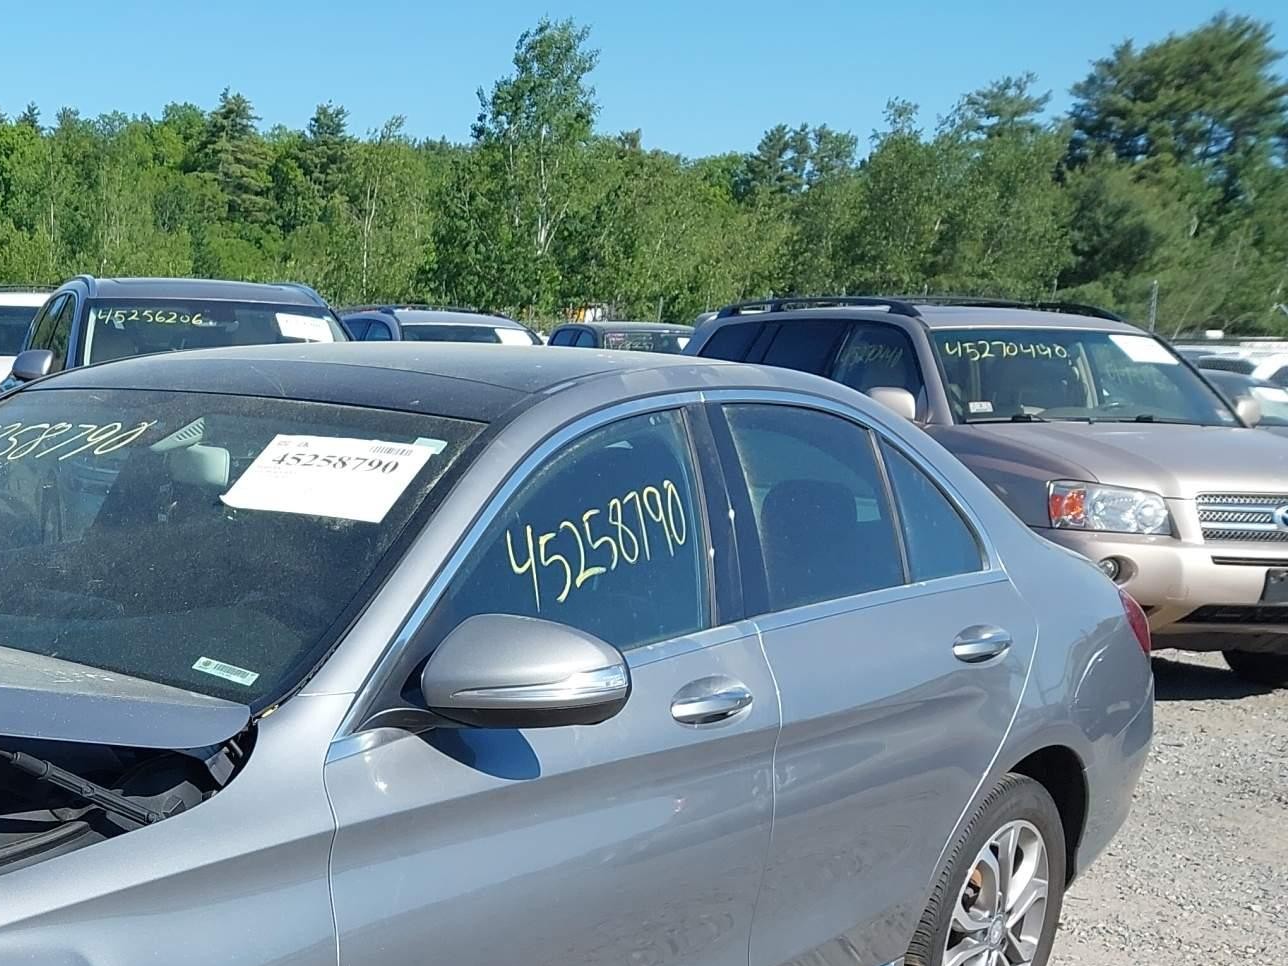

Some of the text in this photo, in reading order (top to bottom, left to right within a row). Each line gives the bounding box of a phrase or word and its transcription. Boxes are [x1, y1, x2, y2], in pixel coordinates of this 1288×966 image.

[98, 309, 202, 325] 45256206
[945, 340, 1067, 361] 45270440
[272, 452, 399, 475] 45258790
[506, 479, 686, 613] 45258790
